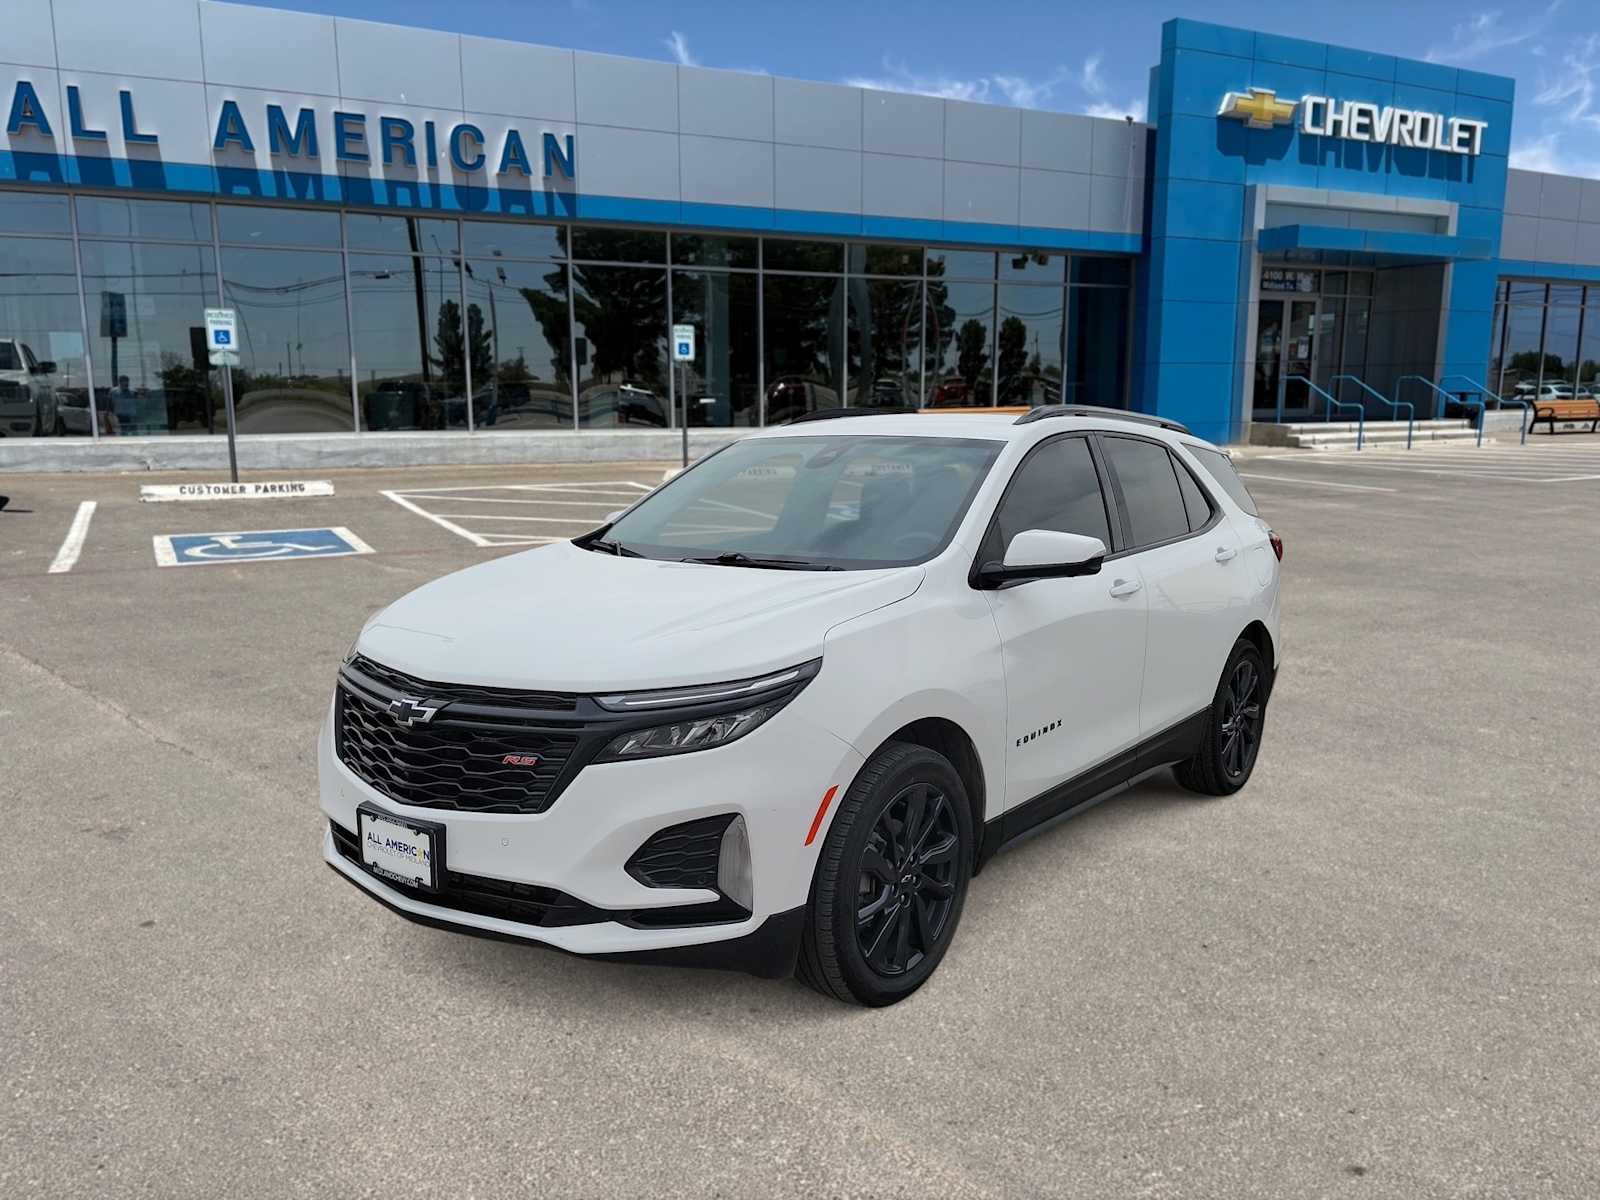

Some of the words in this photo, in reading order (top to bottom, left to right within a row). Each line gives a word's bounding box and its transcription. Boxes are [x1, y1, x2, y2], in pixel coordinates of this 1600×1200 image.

[6, 80, 158, 144] ALL
[213, 99, 576, 179] AMERICAN
[1302, 94, 1488, 156] CHEVROLET
[179, 485, 246, 495] CUSTOMER
[254, 483, 305, 494] PARKING
[1016, 719, 1062, 747] EQUINOX
[502, 755, 538, 766] RS
[367, 831, 382, 845] ALL
